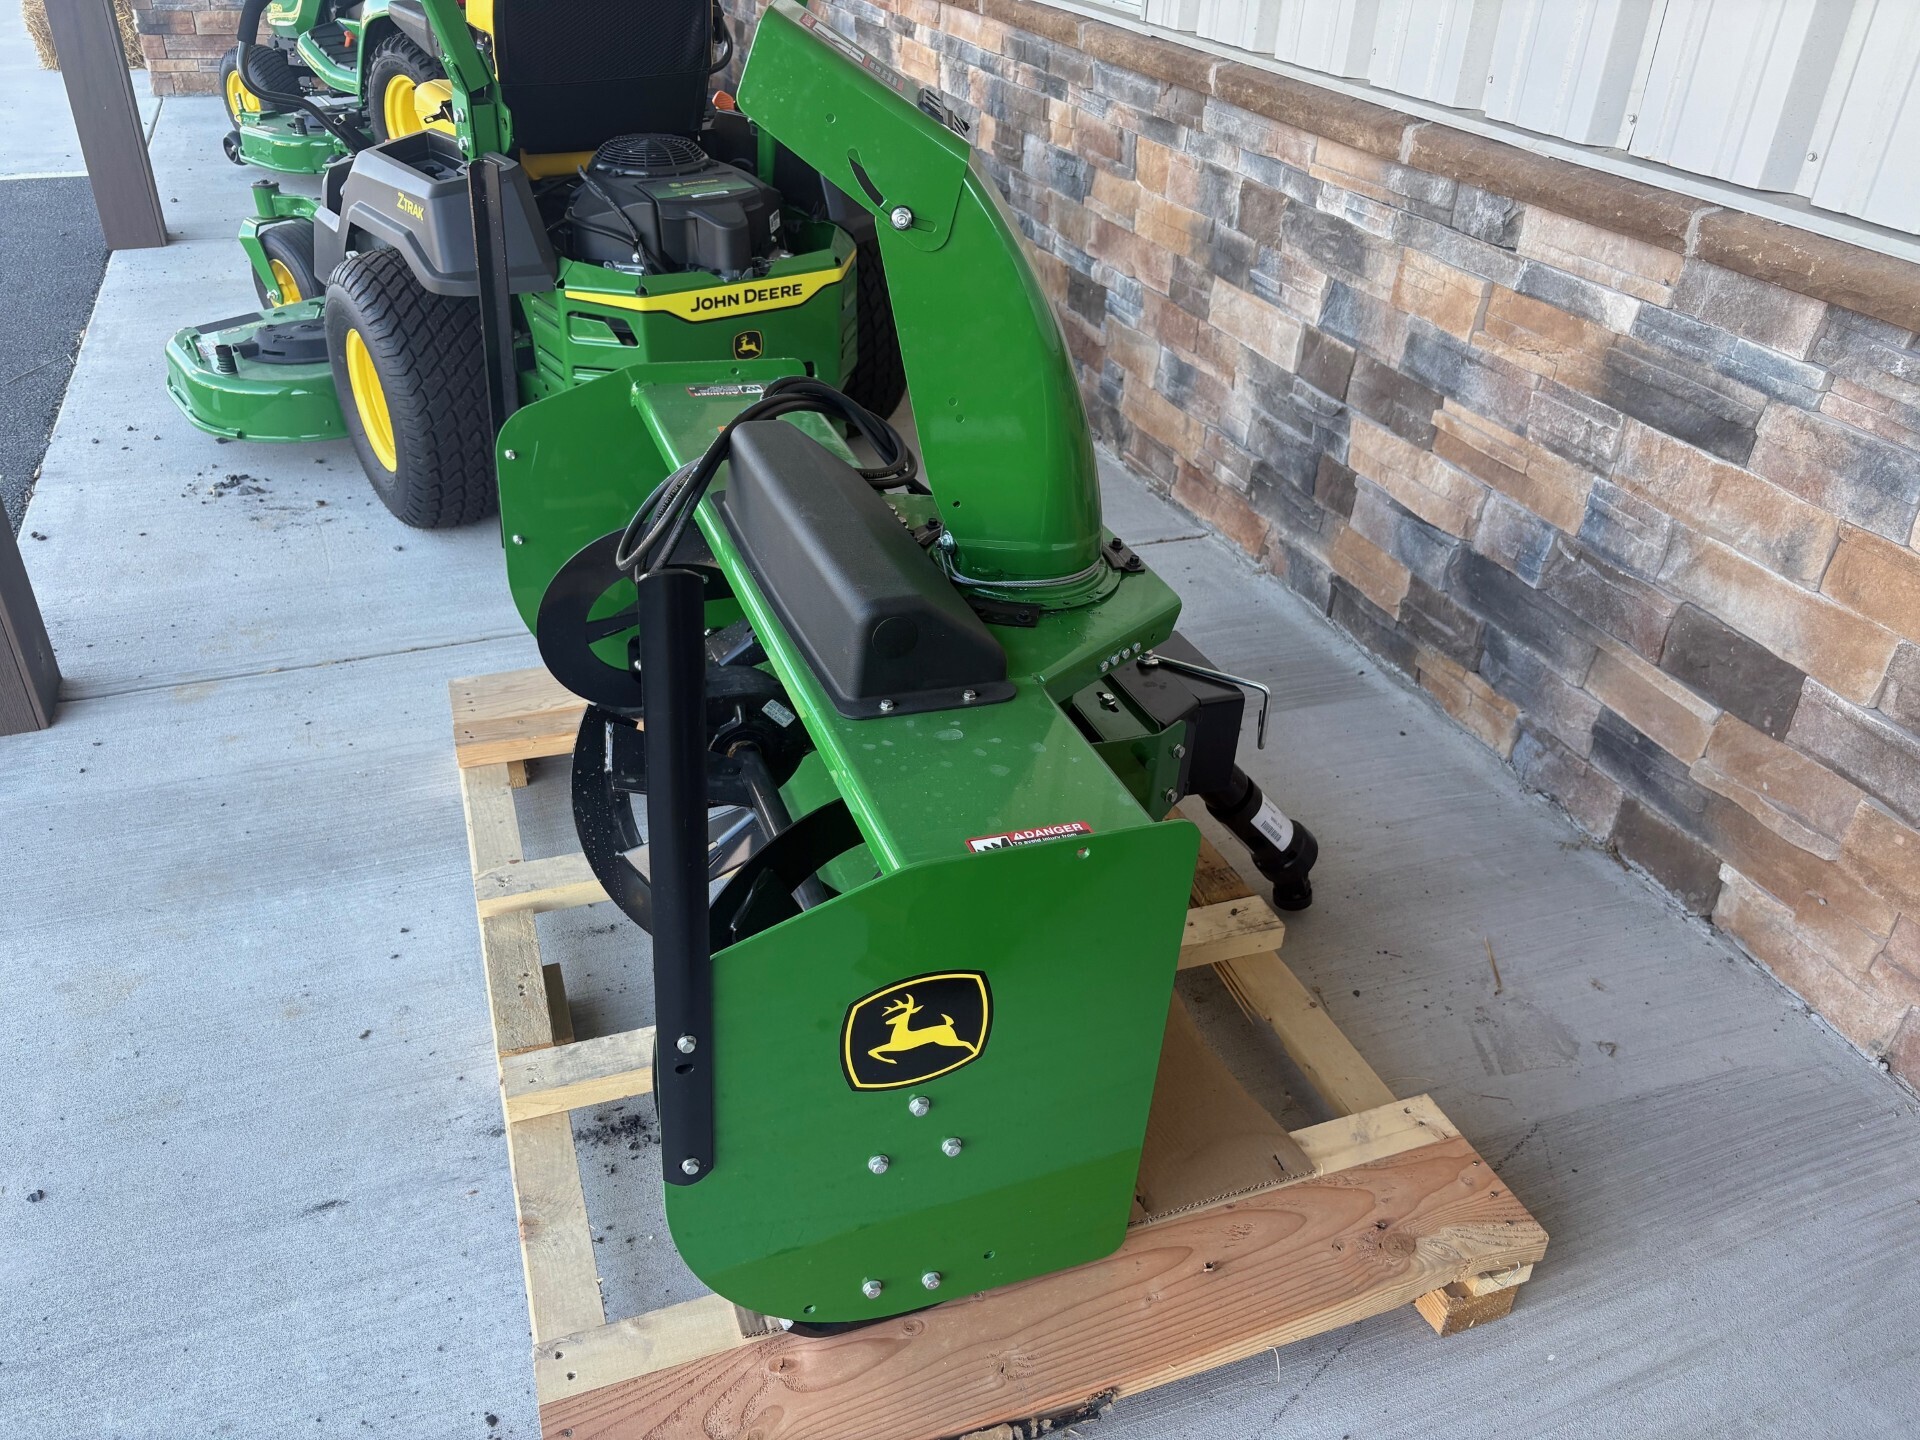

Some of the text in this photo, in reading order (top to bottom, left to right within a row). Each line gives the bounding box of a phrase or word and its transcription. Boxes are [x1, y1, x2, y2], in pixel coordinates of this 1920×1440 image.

[396, 191, 425, 221] ZTRAK
[690, 283, 803, 313] JOHN DEERE
[1024, 823, 1084, 839] DANGER
